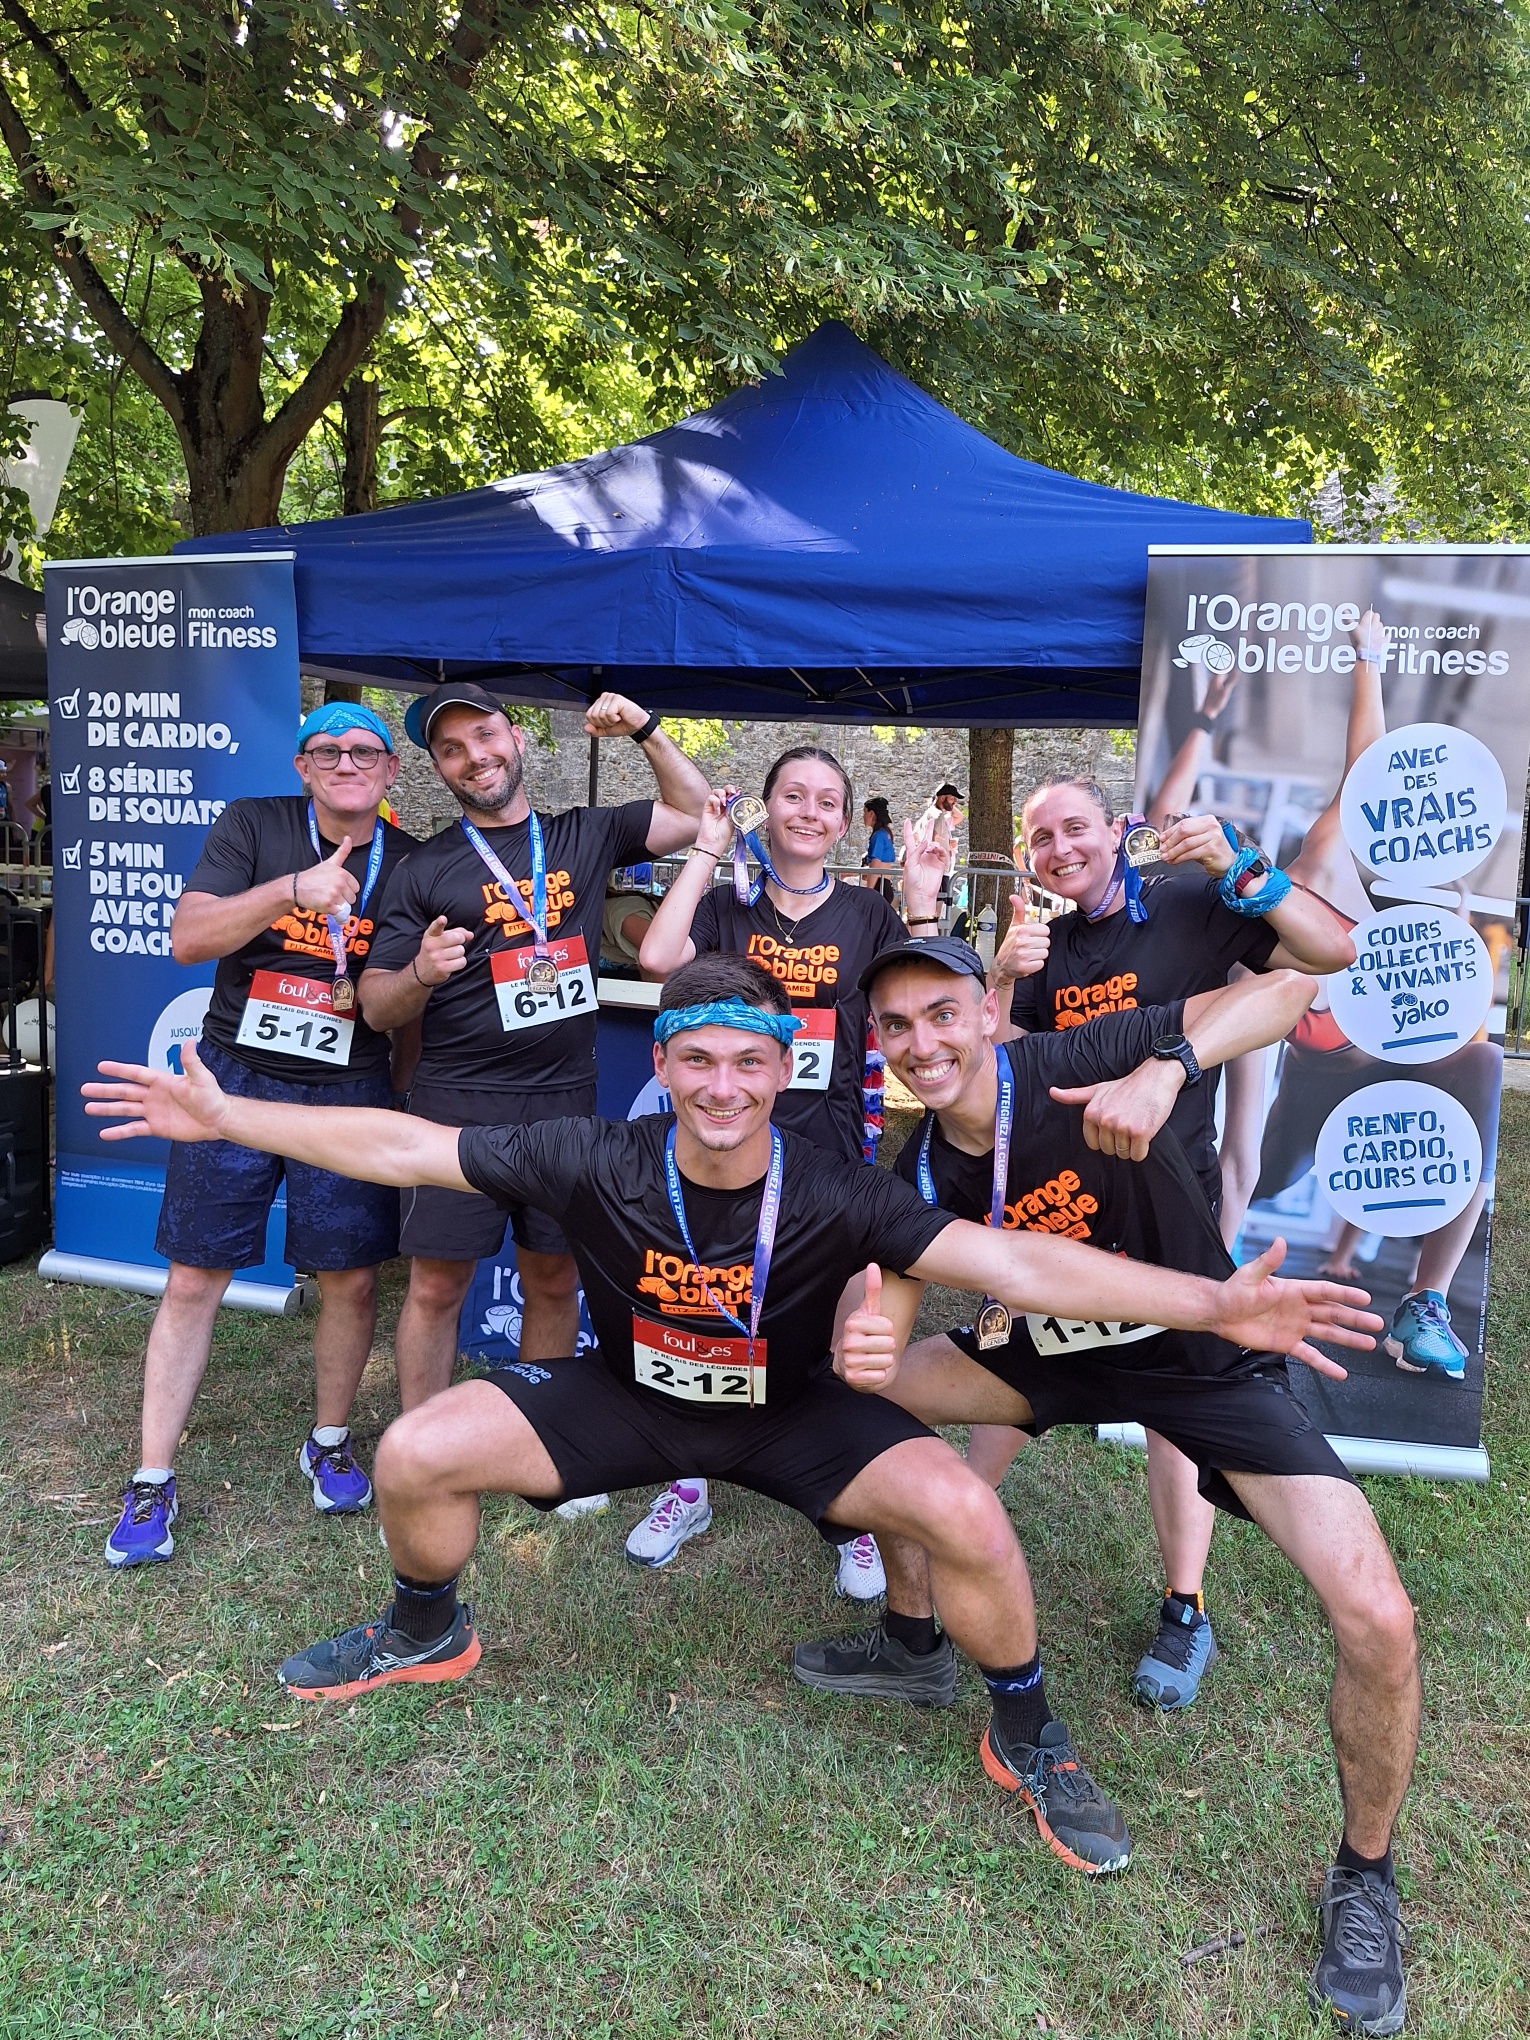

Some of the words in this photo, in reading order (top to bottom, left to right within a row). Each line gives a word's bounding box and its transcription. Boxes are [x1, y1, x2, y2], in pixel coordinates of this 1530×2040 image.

[67, 585, 176, 621] l'Orange
[188, 606, 214, 619] mon
[218, 604, 255, 619] coach
[1186, 594, 1361, 643] l'Orange
[96, 618, 176, 649] bleue
[188, 622, 278, 649] Fitness
[1382, 625, 1419, 640] mon
[1424, 623, 1480, 641] coach
[1238, 637, 1357, 674] bleue
[1379, 643, 1510, 676] Fitness
[86, 692, 123, 719] 20
[126, 692, 181, 719] MIN
[87, 721, 122, 747] DE
[124, 722, 240, 755] CARDIO,
[1387, 744, 1450, 773] AVEC
[88, 768, 107, 794] 8
[111, 762, 194, 795] SÉRIES
[1403, 772, 1437, 791] DES
[88, 797, 123, 822] DE
[1360, 787, 1478, 833] VRAIS
[89, 842, 106, 868] 5
[109, 842, 165, 869] MIN
[374, 828, 382, 854] CLOCHE
[466, 825, 489, 855] ATTEIGNEZ
[485, 852, 494, 863] LA
[491, 860, 511, 886] CLOCHE
[534, 839, 542, 873] ATTEIGNEZ
[969, 852, 999, 861] INTERS
[1368, 823, 1493, 866] COACHS
[372, 855, 380, 864] LA
[90, 872, 124, 896] DE
[126, 872, 187, 899] FOU
[481, 869, 571, 904] l'Orage
[738, 861, 747, 893] CLOCHE
[1103, 880, 1120, 905] CLOCHE
[90, 899, 159, 926] AVEC
[740, 894, 747, 903] LA
[90, 928, 176, 956] COACH
[749, 934, 840, 966] l'Orange
[1367, 921, 1442, 948] COURS
[773, 958, 839, 984] bleue
[1351, 977, 1369, 996] &
[1376, 961, 1477, 990] VIVANTS
[514, 979, 587, 1018] 6-12
[1055, 972, 1138, 1011] l'Orange
[271, 1004, 296, 1014] RELAIS
[297, 1009, 310, 1018] DES
[1392, 999, 1450, 1034] yako
[170, 1026, 203, 1038] JUSQU'
[255, 1013, 340, 1054] 5-12
[1000, 1082, 1011, 1136] ATTEIGNEZ
[1347, 1110, 1446, 1137] RENFO,
[923, 1112, 935, 1150] CLOCHE
[998, 1138, 1007, 1149] LA
[769, 1137, 780, 1188] ATTEIGNEZ
[921, 1152, 927, 1164] LA
[1343, 1136, 1454, 1164] CARDIO,
[667, 1149, 677, 1188] CLOCHE
[997, 1152, 1005, 1191] CLOCHE
[1329, 1165, 1416, 1191] COURS
[1423, 1163, 1457, 1185] CO
[1463, 1160, 1471, 1183] !
[673, 1191, 680, 1202] LA
[767, 1190, 777, 1203] LA
[760, 1205, 774, 1245] CLOCHE
[1026, 1193, 1098, 1234] bleue
[661, 1353, 688, 1365] RELAIS
[650, 1359, 749, 1396] 2-12
